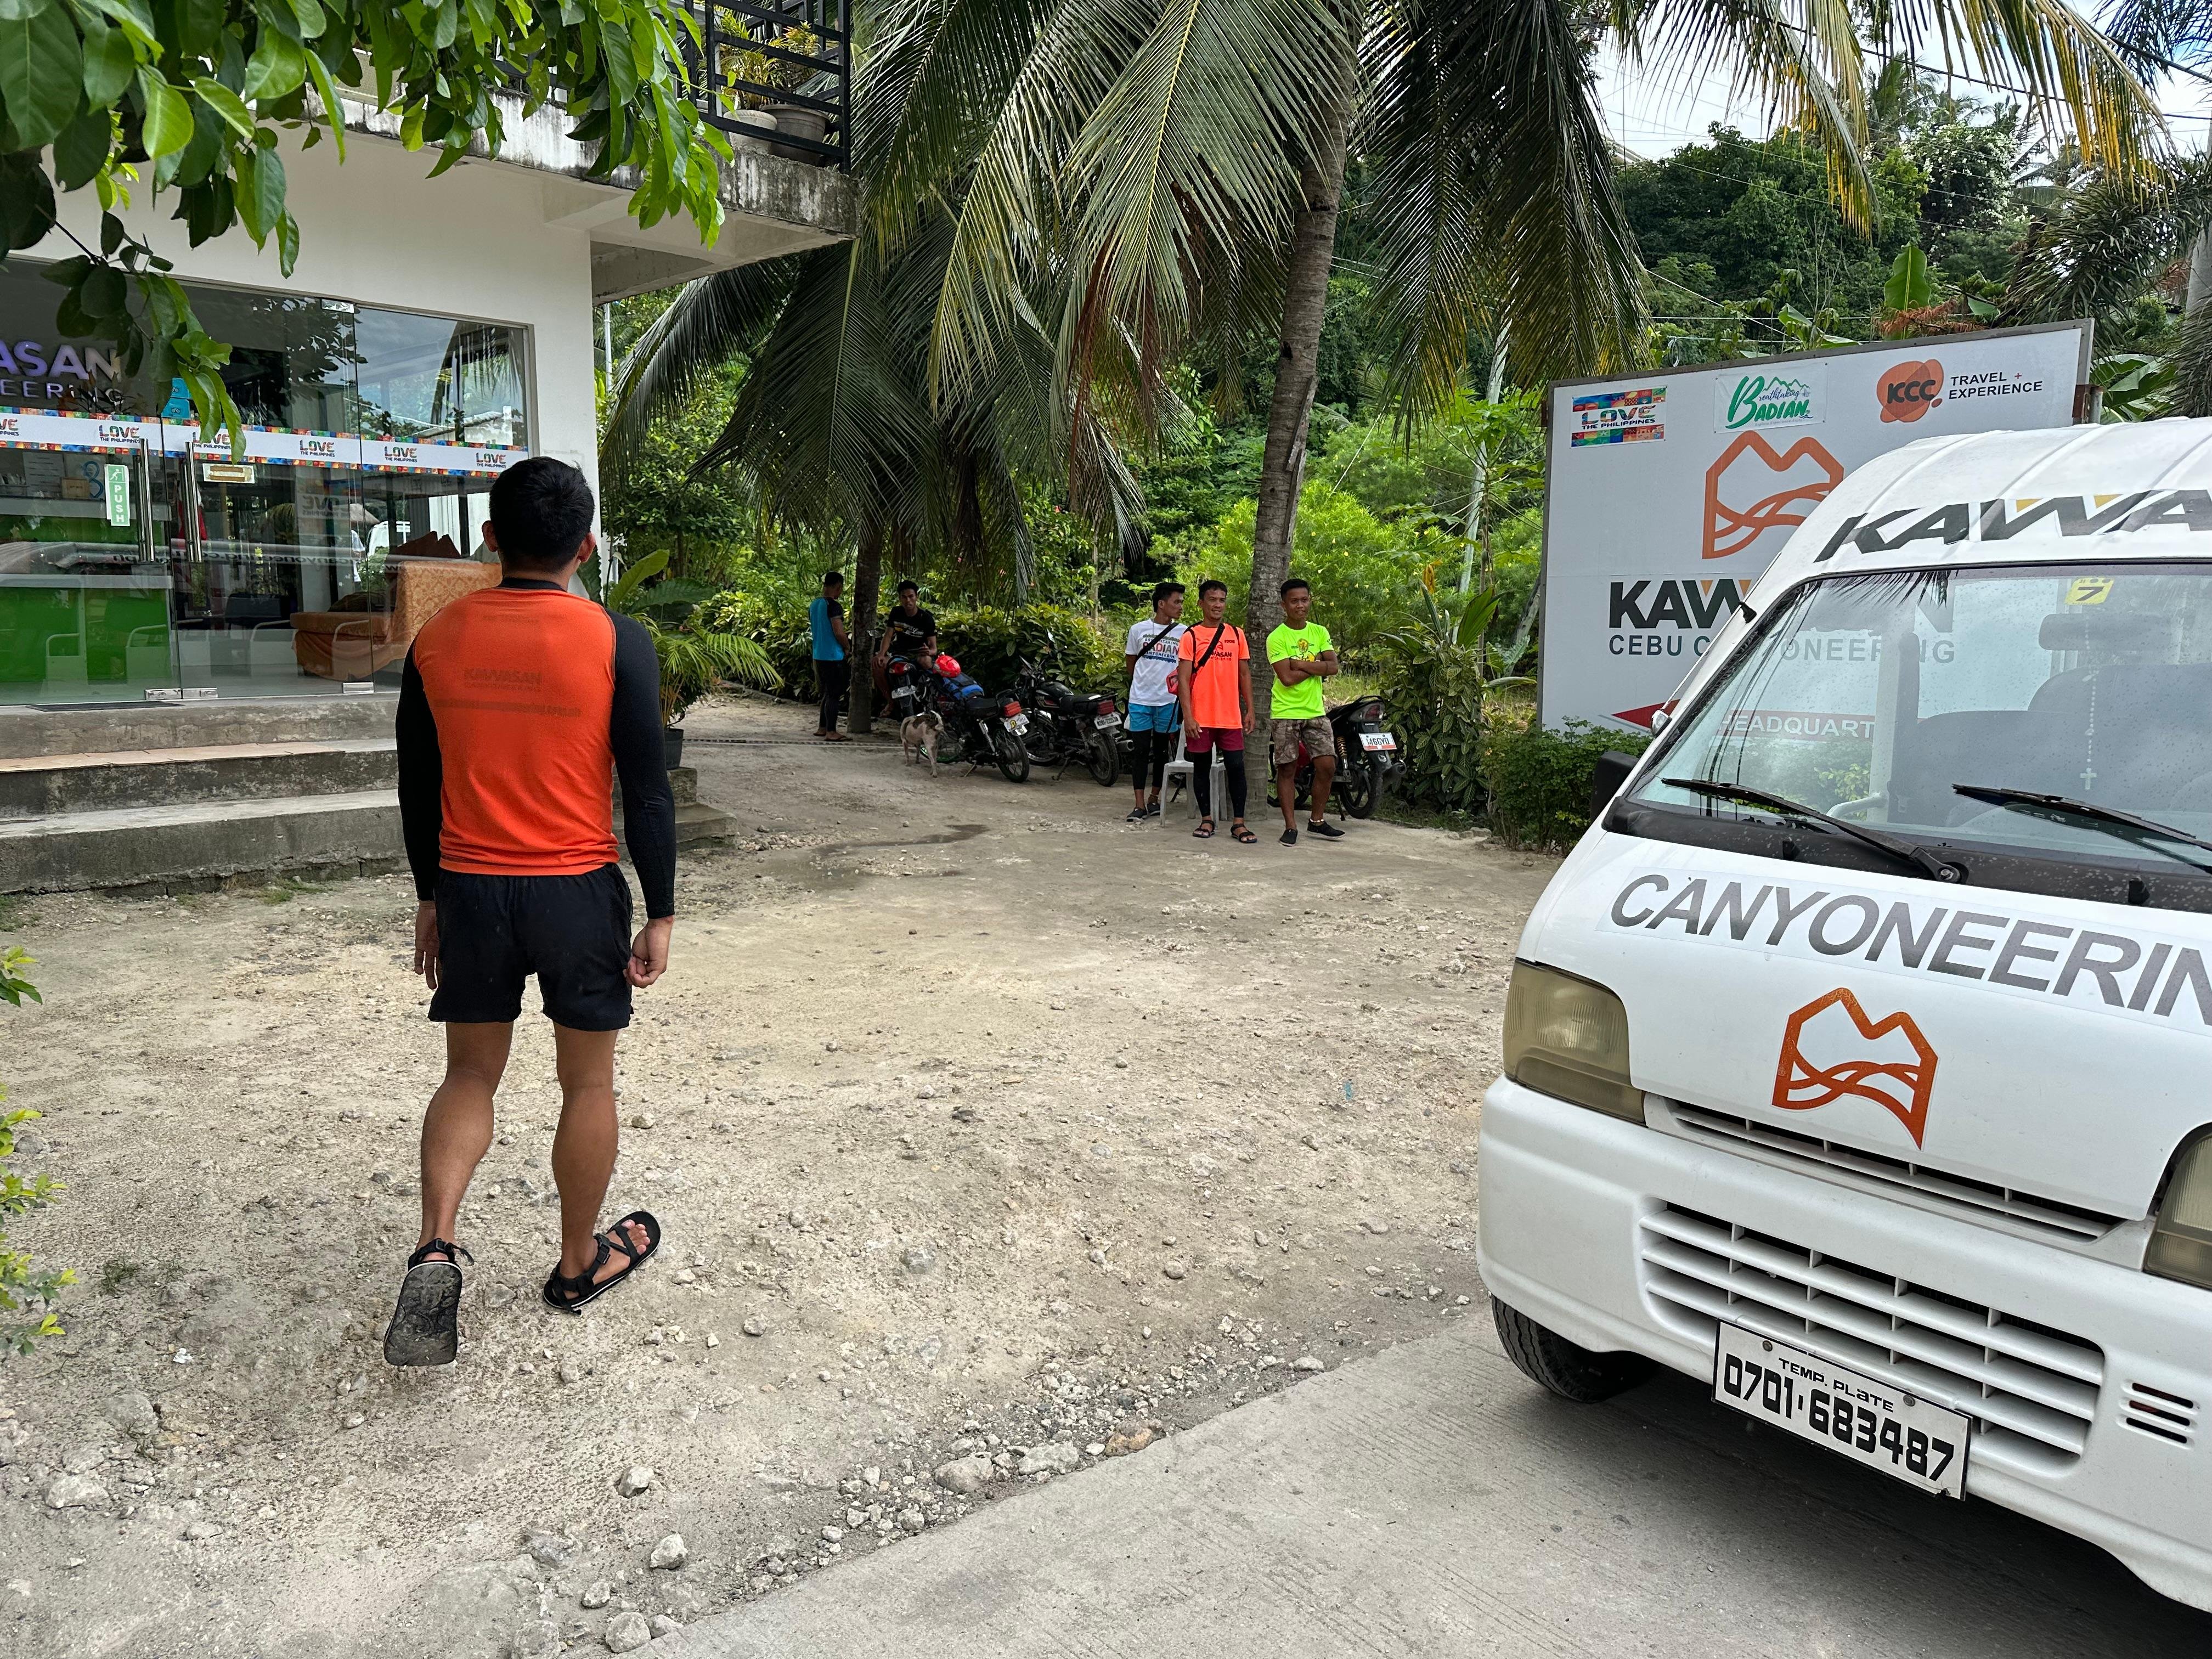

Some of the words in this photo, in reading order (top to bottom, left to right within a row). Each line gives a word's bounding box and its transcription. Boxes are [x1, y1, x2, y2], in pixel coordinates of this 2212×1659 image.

[1950, 372, 2007, 386] TRAVEL
[1887, 380, 1936, 404] KCC
[1949, 381, 2043, 400] EXPERIENCE
[1582, 405, 1656, 425] LOVE
[1601, 419, 1656, 428] PHILIPPINES
[99, 425, 140, 438] LOVE
[300, 439, 335, 453] LOVE
[385, 446, 417, 458] LOVE
[476, 453, 506, 464] LOVE
[114, 484, 125, 523] PUSH
[2076, 586, 2104, 601] 7
[1610, 635, 1682, 656] CEBU
[1779, 1357, 1827, 1386] TEMP.
